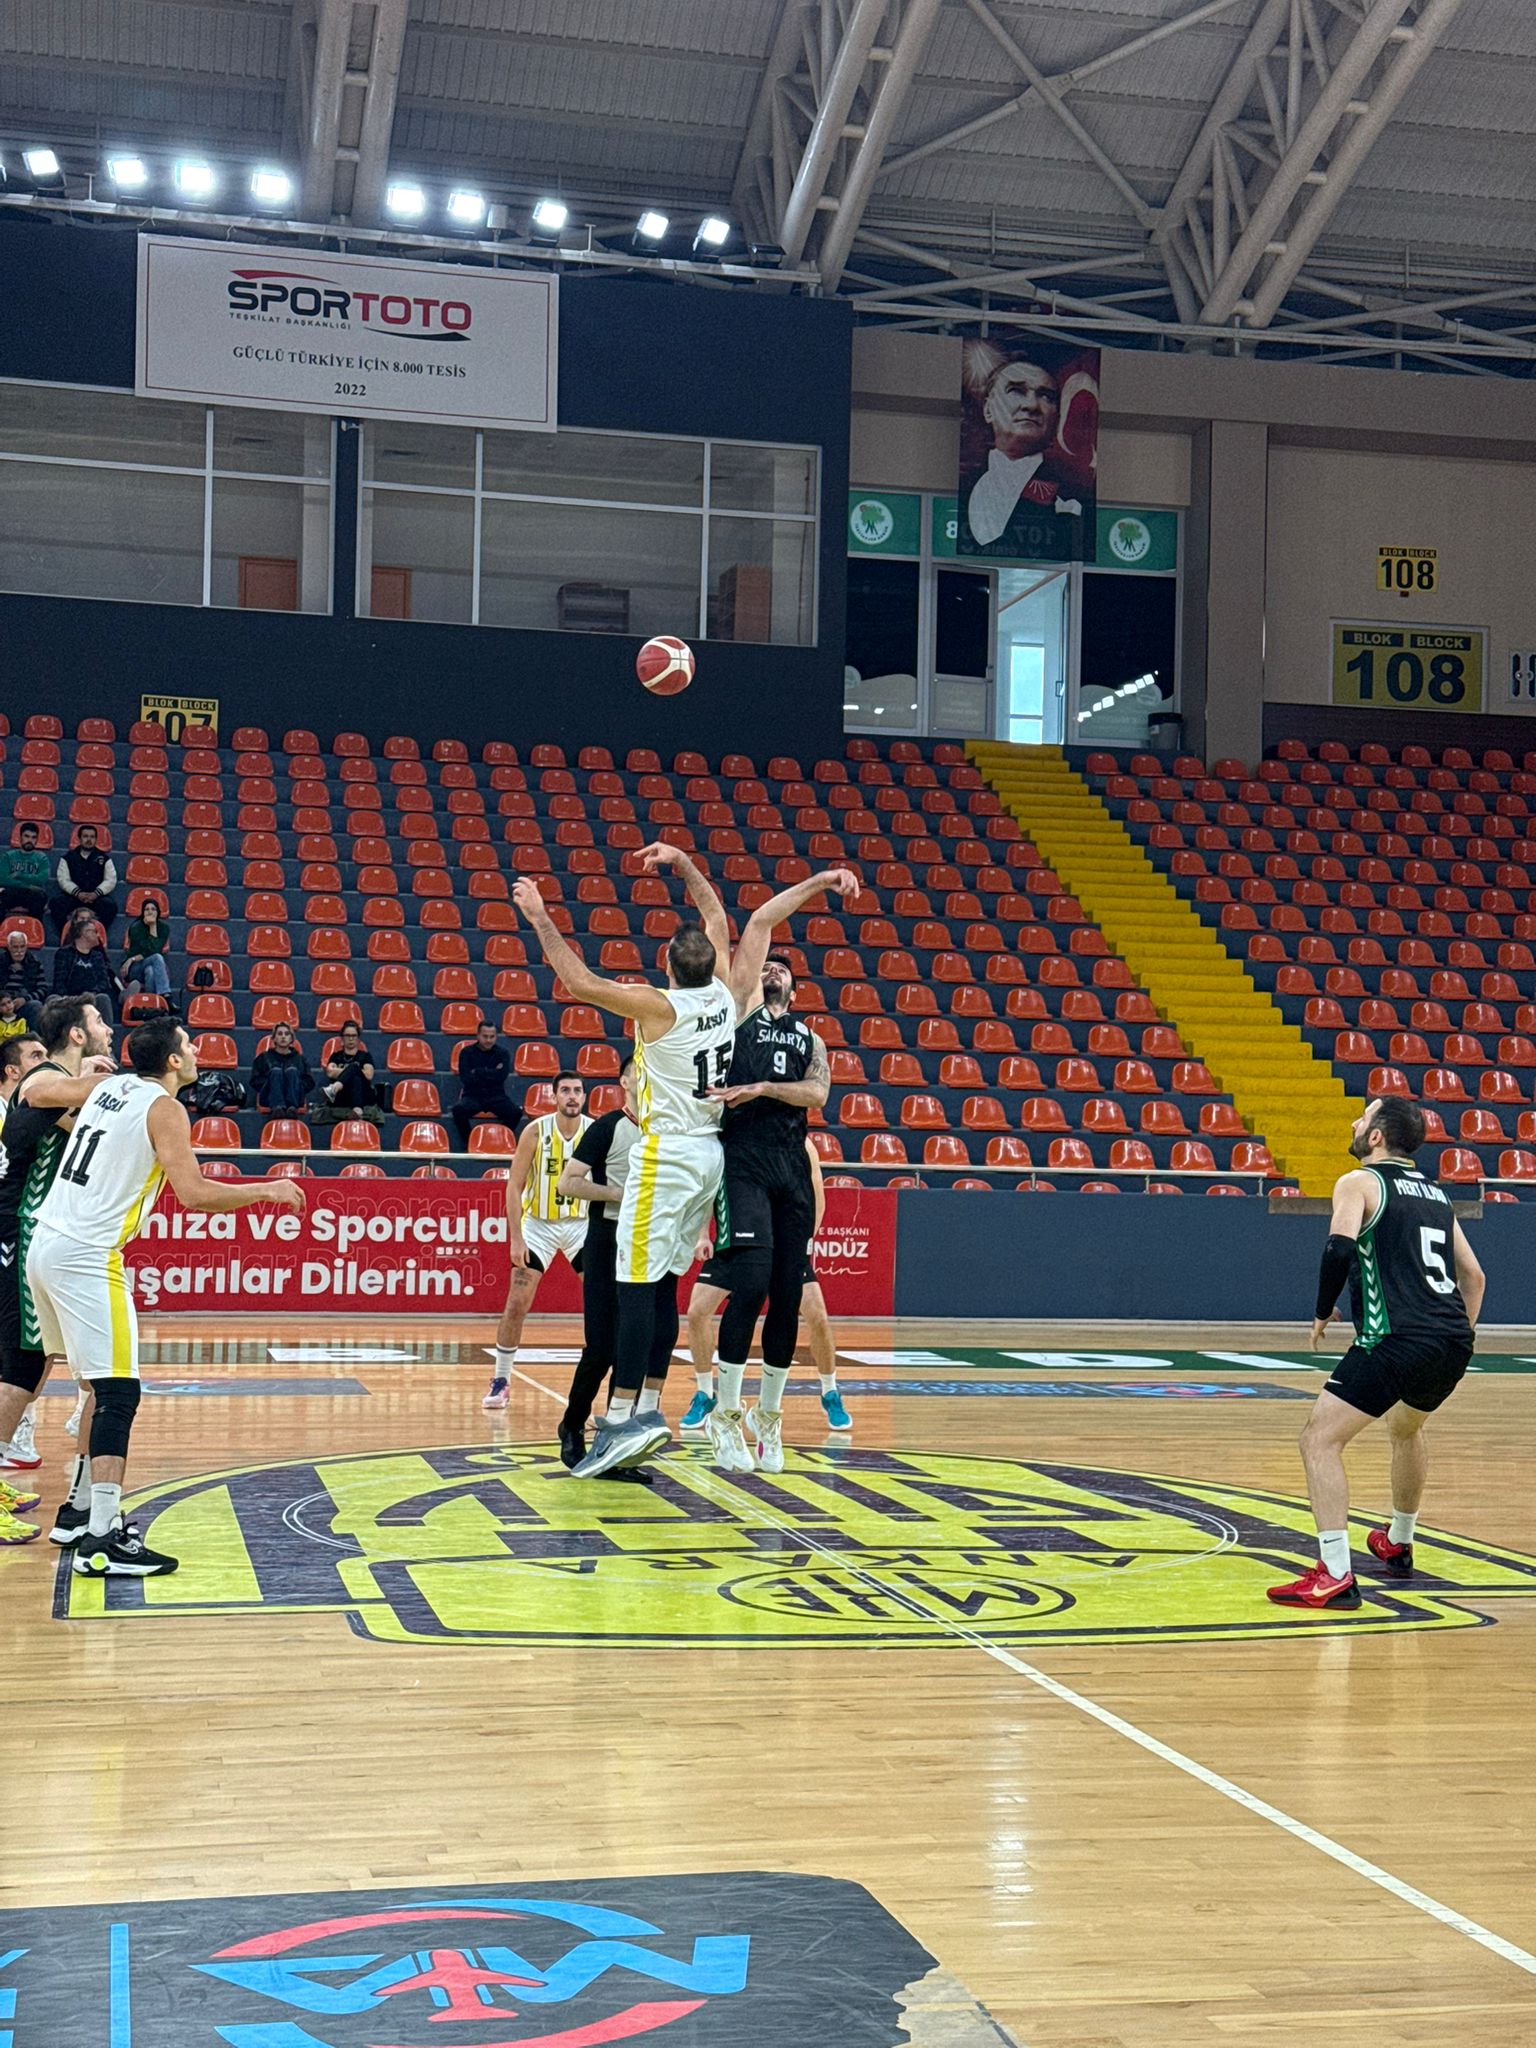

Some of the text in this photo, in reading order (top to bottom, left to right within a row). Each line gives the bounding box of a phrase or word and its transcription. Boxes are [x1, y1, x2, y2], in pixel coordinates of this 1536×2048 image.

[229, 312, 351, 331] TEŞKİLAT BAŞKANLIĞI
[233, 345, 466, 378] GÜÇLÜ TÜRKİYE İÇİN 8.000 TESİS
[334, 382, 367, 397] 2022
[1382, 548, 1436, 558] BLOK BLOCK
[1381, 559, 1434, 590] 108
[1353, 633, 1464, 649] BLOK BLOCK
[1346, 650, 1466, 704] 108
[148, 698, 214, 710] BLOK BLOCK
[757, 1028, 807, 1055] SAKARYA
[692, 1040, 732, 1099] 15
[773, 1050, 787, 1075] 9
[60, 1124, 107, 1187] 11
[247, 1214, 301, 1241] ve
[311, 1208, 507, 1253] Sporcula
[827, 1227, 870, 1237] BAŞKANI
[814, 1238, 869, 1258] NDÜZ
[1420, 1226, 1456, 1294] 5
[130, 1258, 474, 1306] şarılar Dilerim.
[518, 1553, 1139, 1575] ANKARA
[755, 1571, 1041, 1619] MKE
